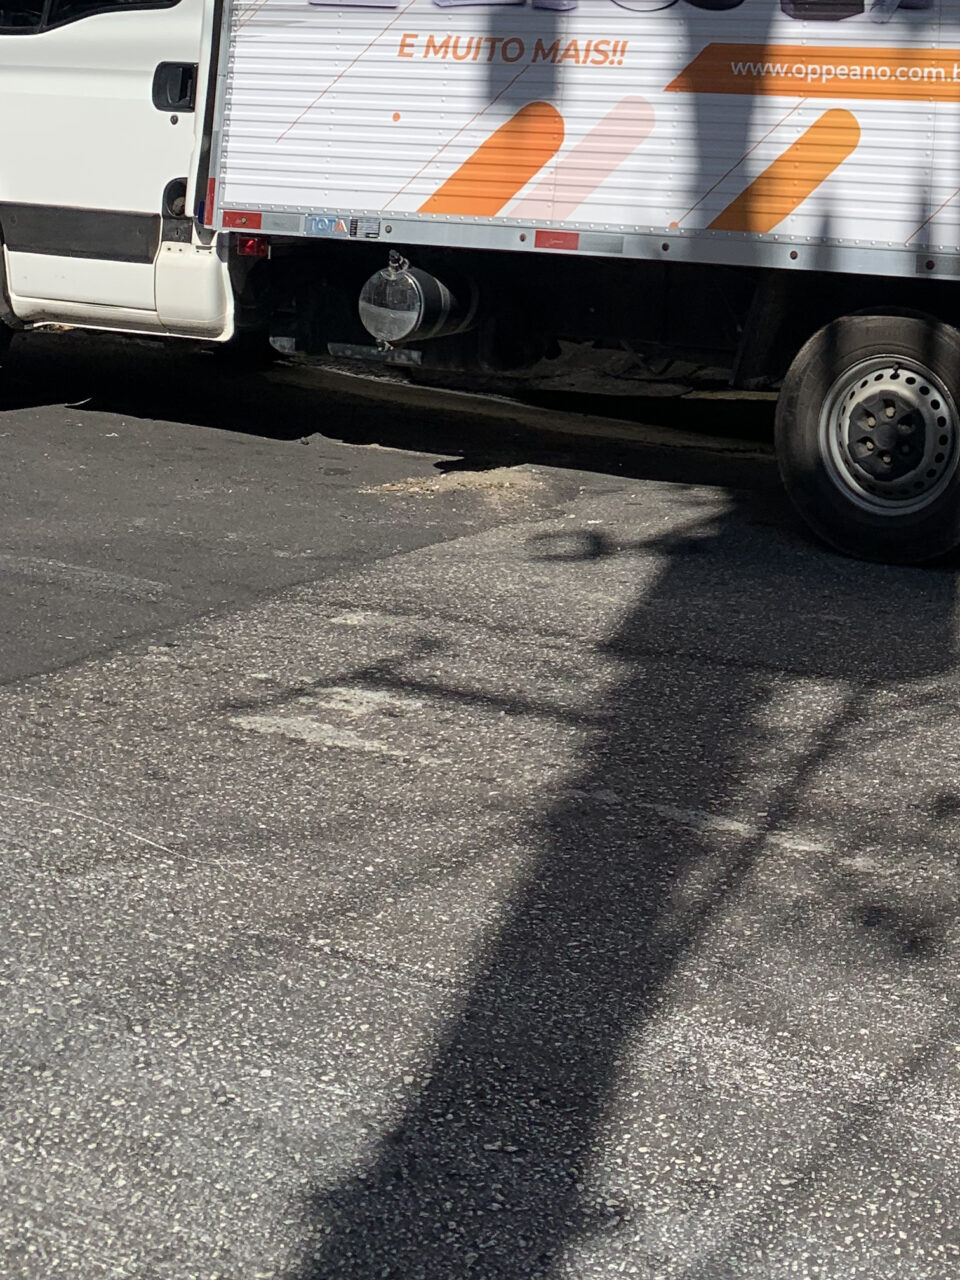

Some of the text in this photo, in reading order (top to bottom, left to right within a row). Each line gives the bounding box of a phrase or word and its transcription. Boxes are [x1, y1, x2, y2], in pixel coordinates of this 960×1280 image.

[397, 33, 630, 66] E MUITO MAIS!!
